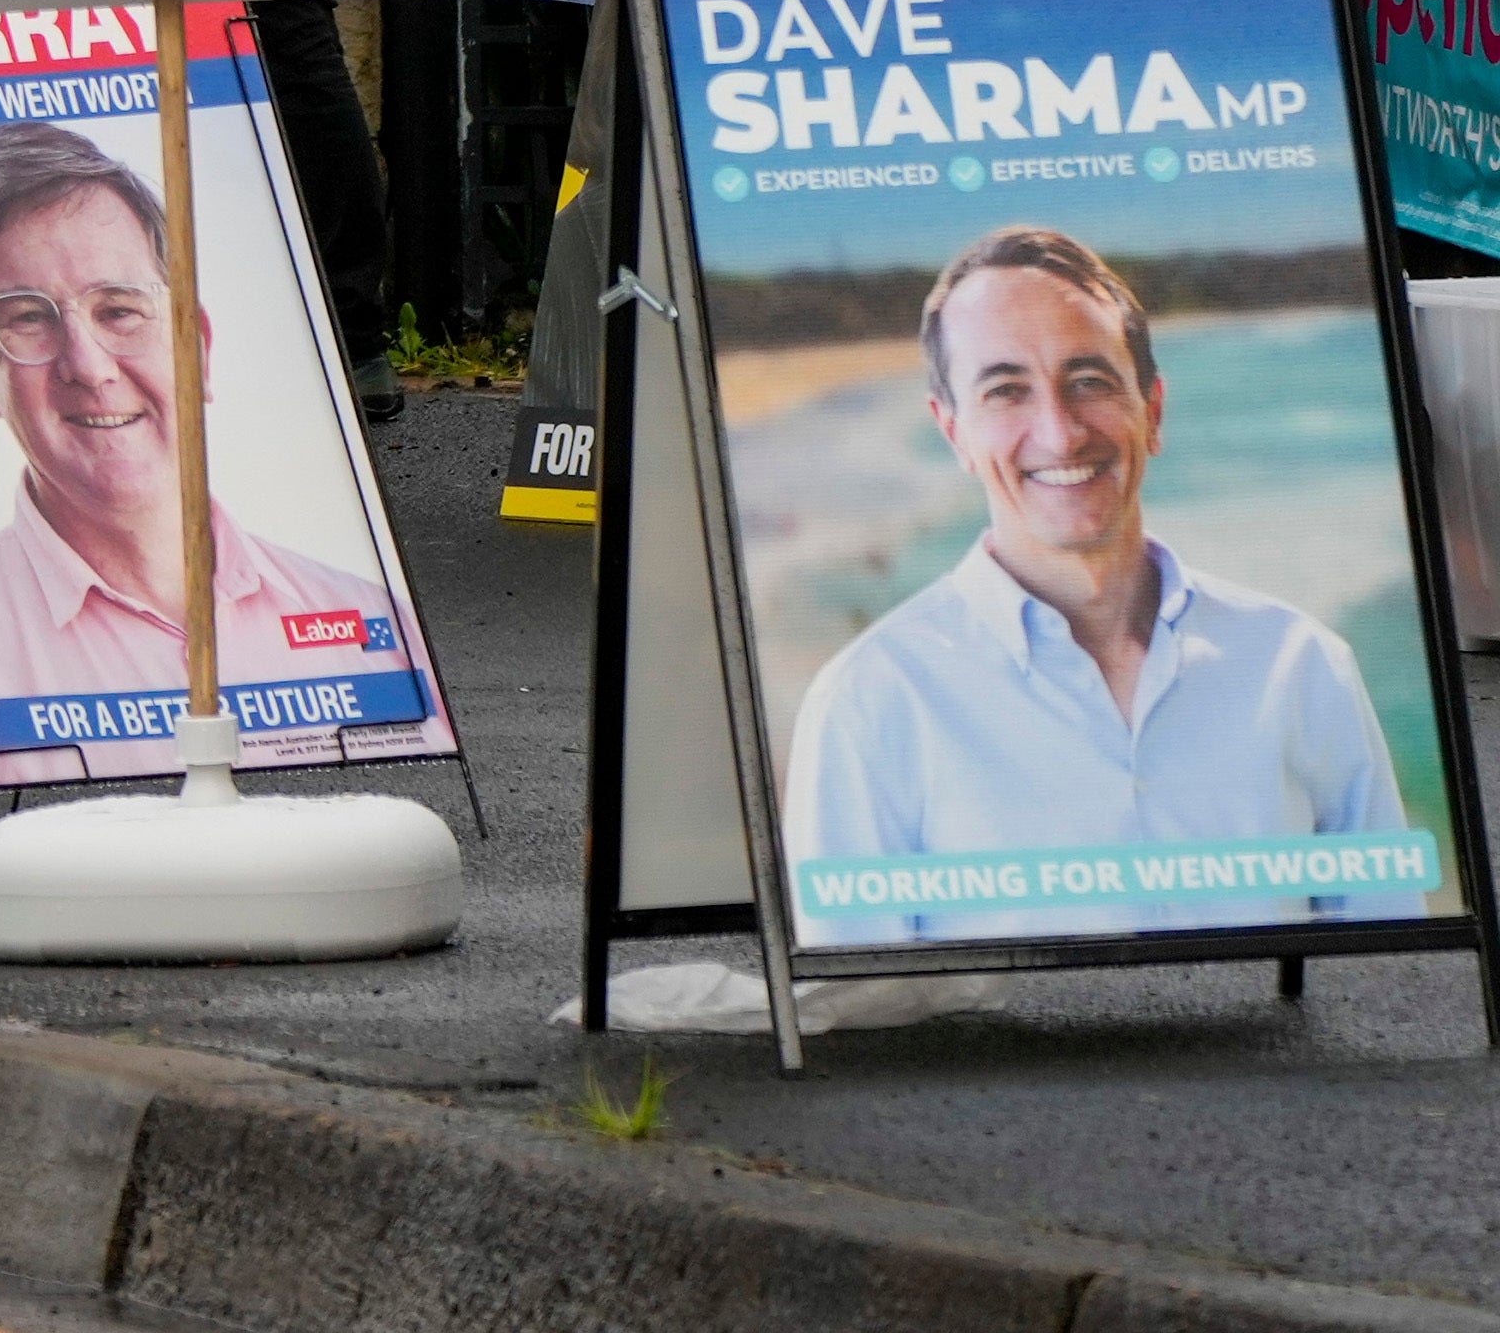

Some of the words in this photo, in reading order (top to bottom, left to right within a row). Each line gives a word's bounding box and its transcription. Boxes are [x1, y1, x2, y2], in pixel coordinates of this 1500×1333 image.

[706, 51, 1218, 154] SHARMA
[1216, 81, 1308, 129] MP
[755, 163, 940, 194] EXPERIENCED
[990, 153, 1136, 183] EFFECTIVE
[1186, 145, 1316, 175] DELIVERS
[529, 423, 595, 477] FOR
[289, 617, 357, 645] Labor
[28, 699, 81, 740] FOR
[97, 696, 122, 737] A
[235, 683, 362, 728] FUTURE
[811, 864, 1029, 907] WORKING
[1039, 861, 1126, 895] FOR
[1134, 847, 1426, 893] WENTWORTH
